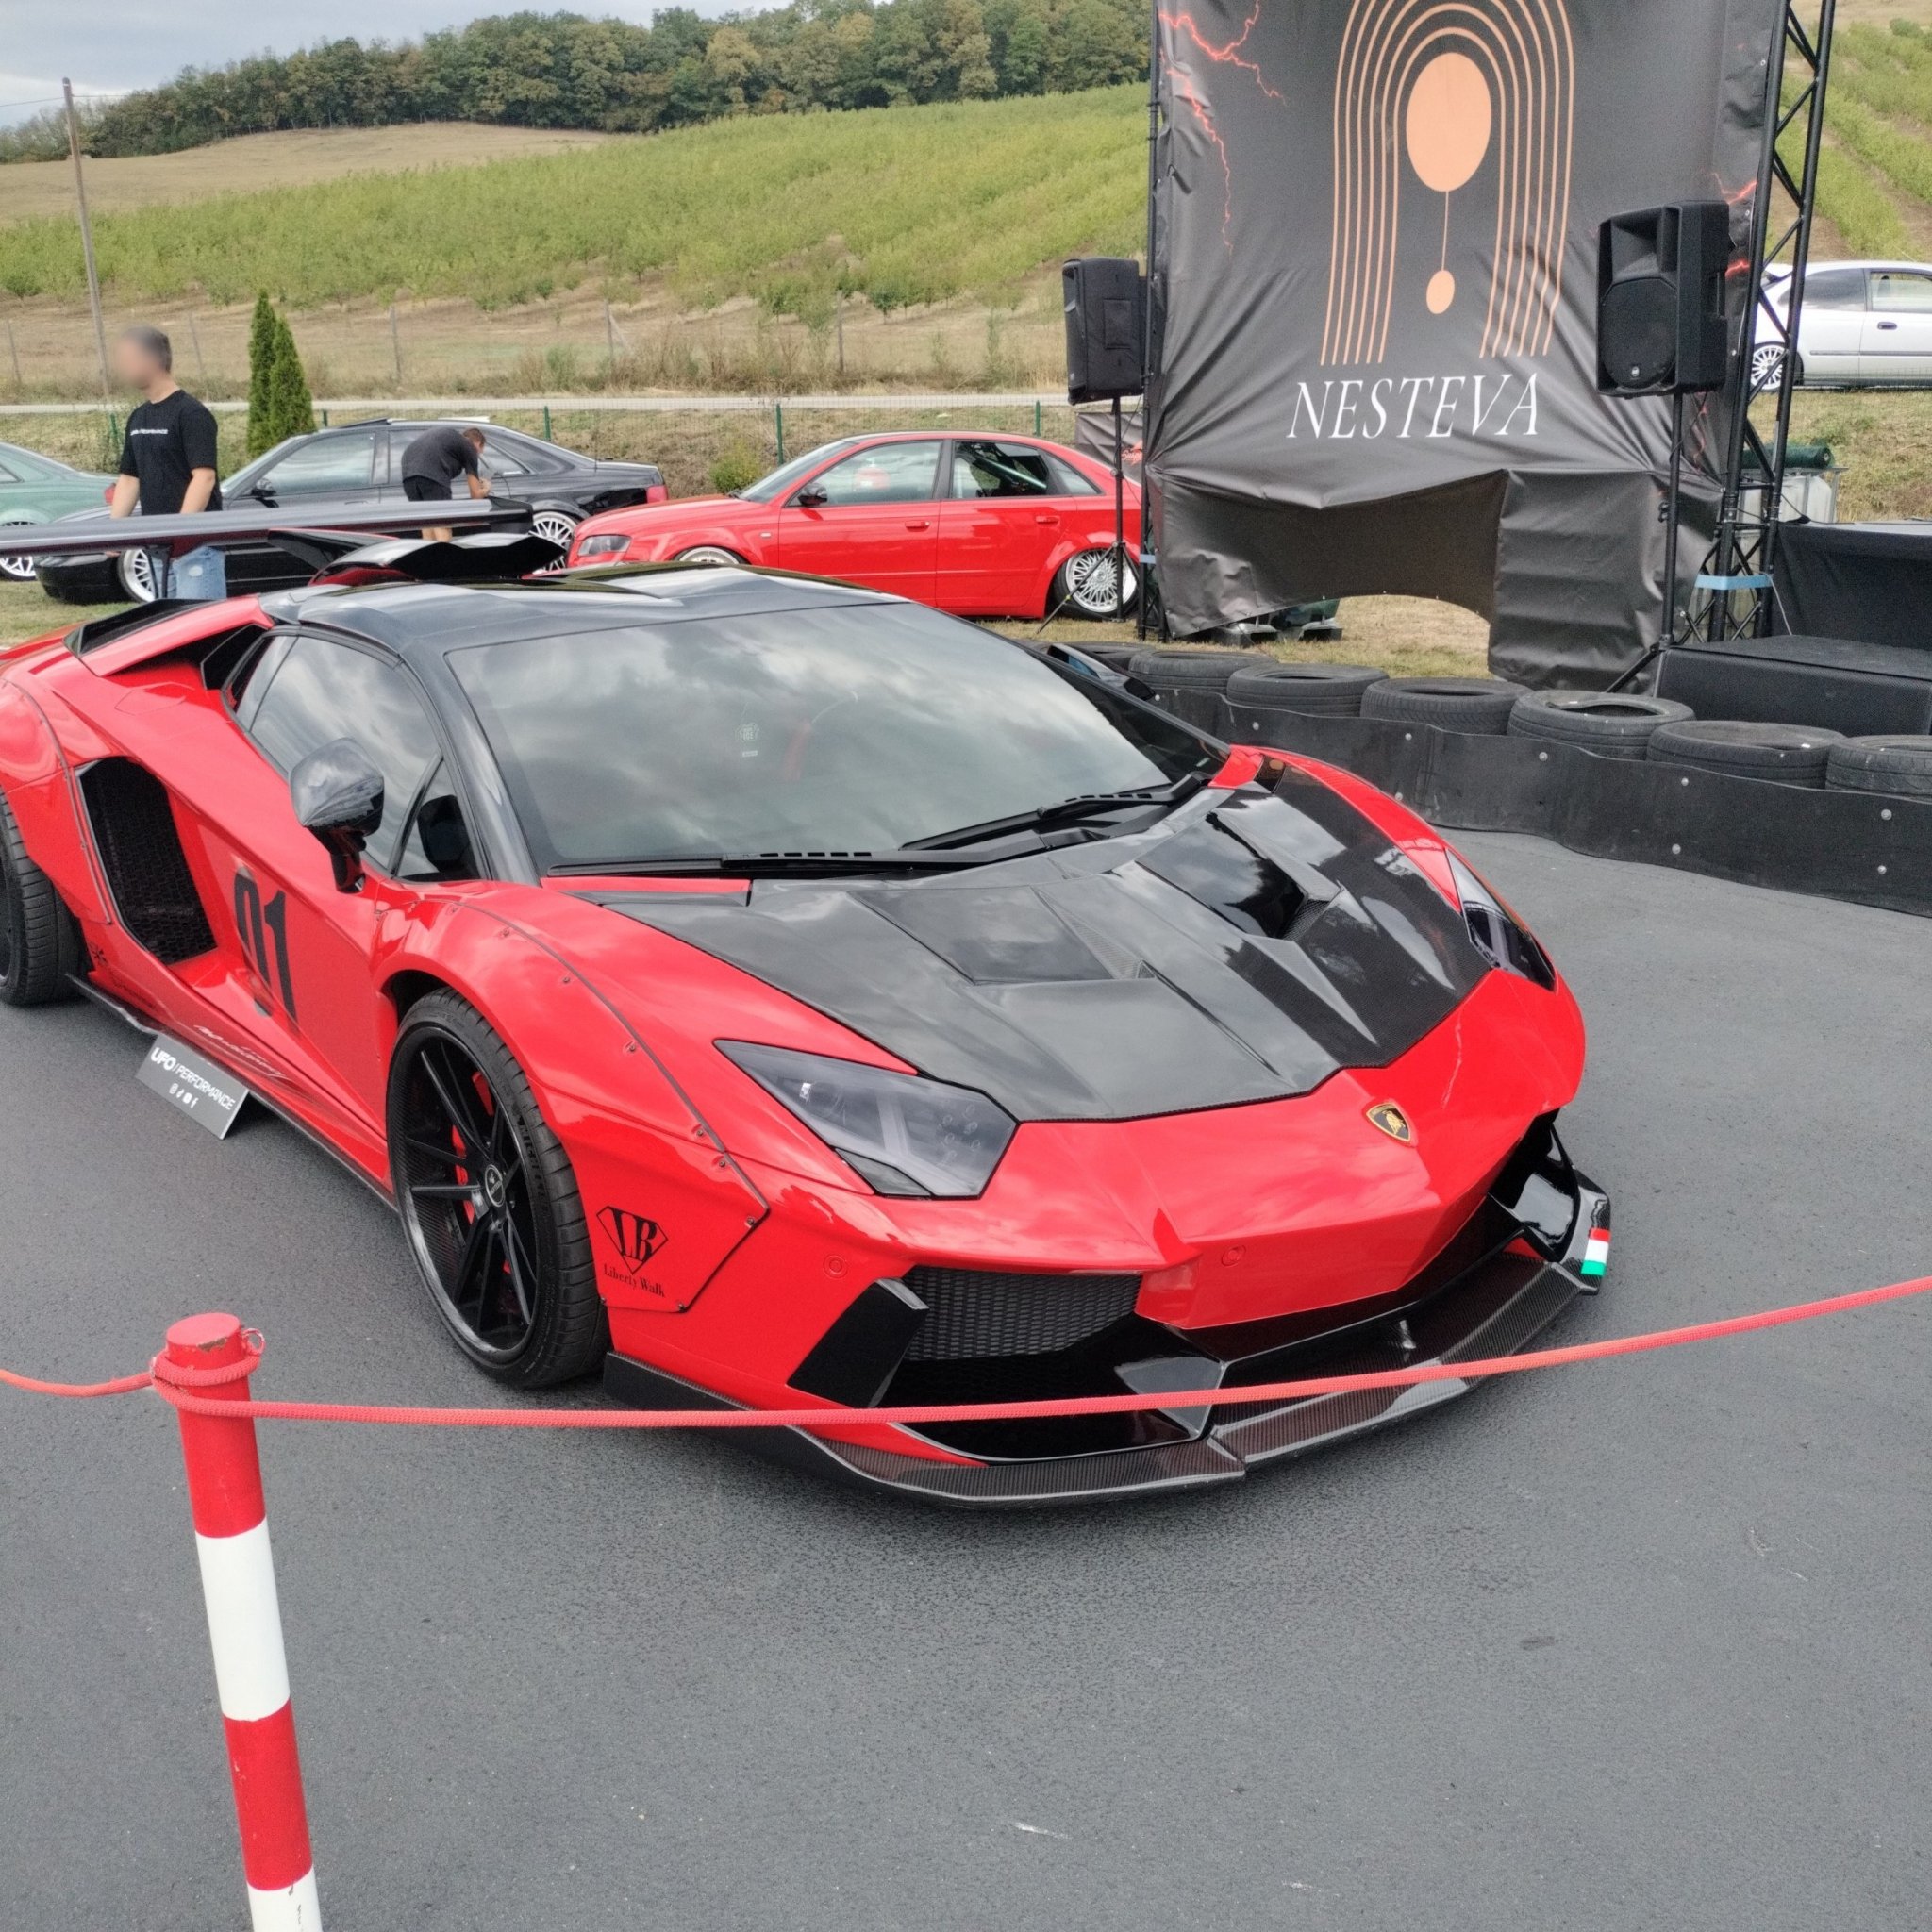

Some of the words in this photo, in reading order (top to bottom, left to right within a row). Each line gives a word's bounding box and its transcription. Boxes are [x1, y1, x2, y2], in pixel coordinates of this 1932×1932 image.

[1286, 372, 1539, 439] NESTEVA
[233, 865, 299, 1026] 01
[604, 1263, 638, 1290] Liberty
[640, 1276, 665, 1298] Walk
